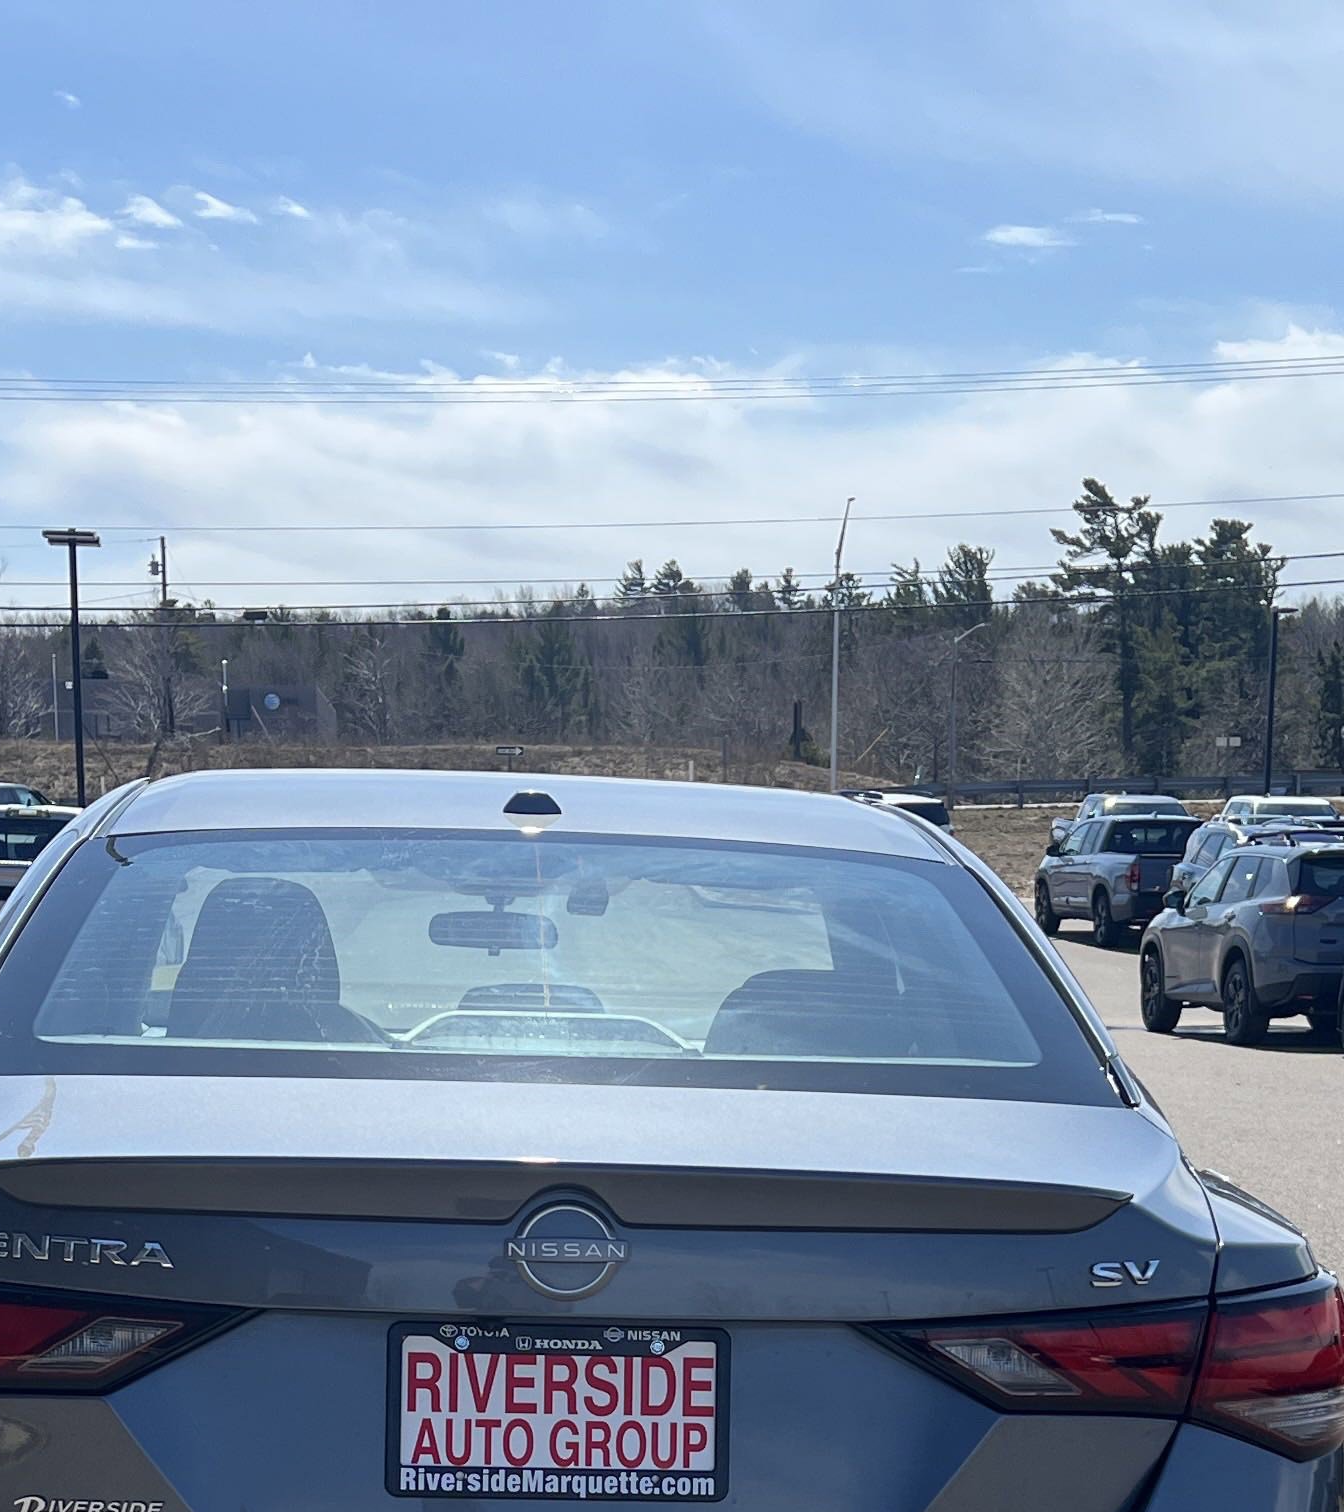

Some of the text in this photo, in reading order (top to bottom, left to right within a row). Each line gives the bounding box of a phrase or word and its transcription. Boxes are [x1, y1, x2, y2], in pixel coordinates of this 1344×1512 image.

[508, 1242, 625, 1258] NISSAN
[1090, 1260, 1160, 1287] SV
[534, 1339, 602, 1350] HONDA
[627, 1330, 681, 1342] NISSAN
[407, 1352, 715, 1417] RIVERSIDE
[411, 1418, 708, 1469] AUTO GROUP
[399, 1467, 715, 1498] RiversideMarquette.com
